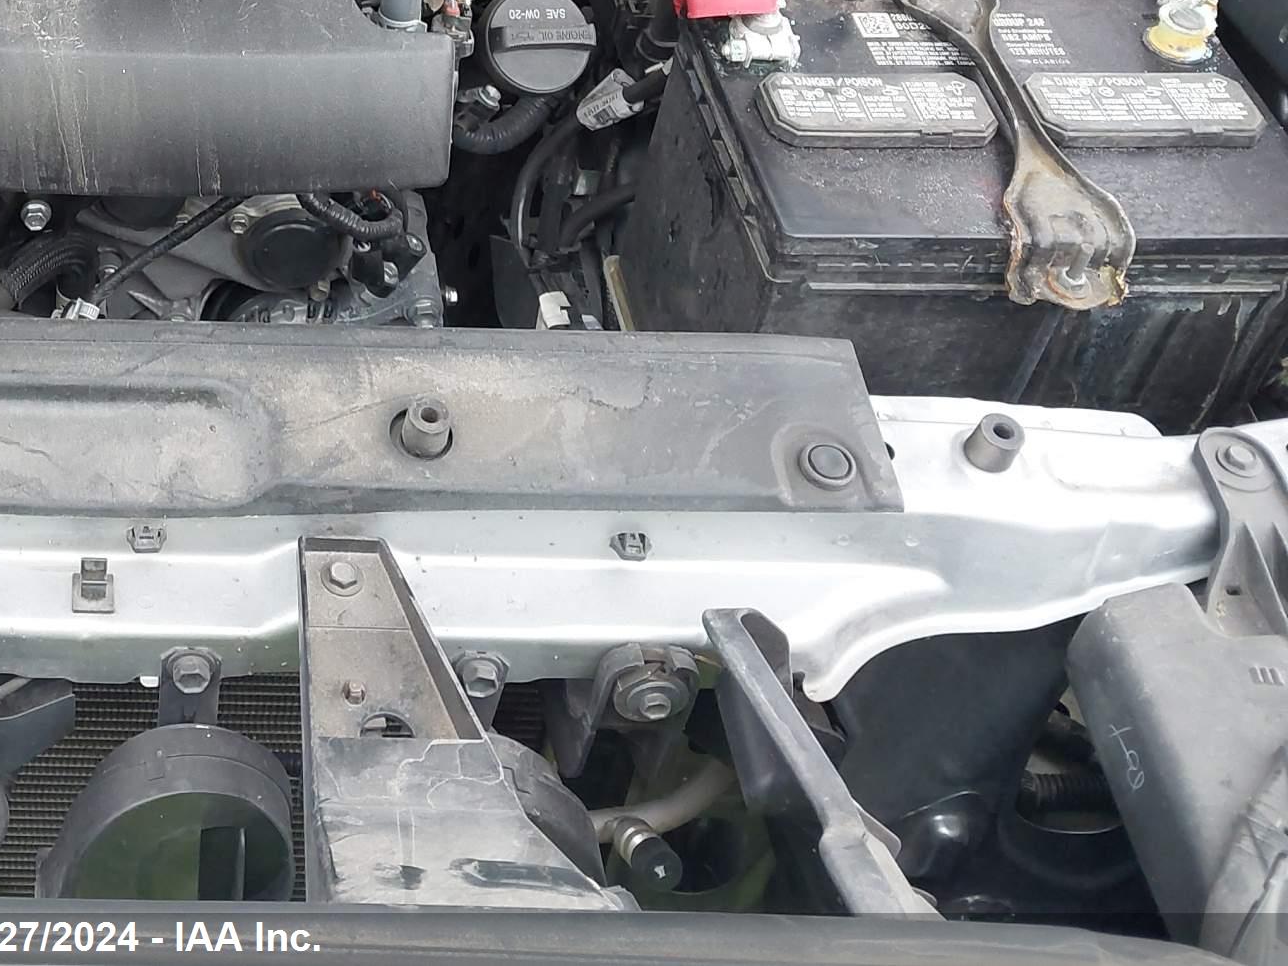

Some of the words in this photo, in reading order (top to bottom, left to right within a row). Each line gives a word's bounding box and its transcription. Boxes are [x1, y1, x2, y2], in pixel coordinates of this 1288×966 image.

[509, 8, 540, 20] 0W-20
[546, 8, 566, 20] SAE
[556, 30, 593, 40] ENGINE
[793, 76, 836, 87] DANGER
[844, 77, 883, 87] POISON
[1052, 76, 1097, 87] DANGER
[1104, 77, 1146, 87] POISON
